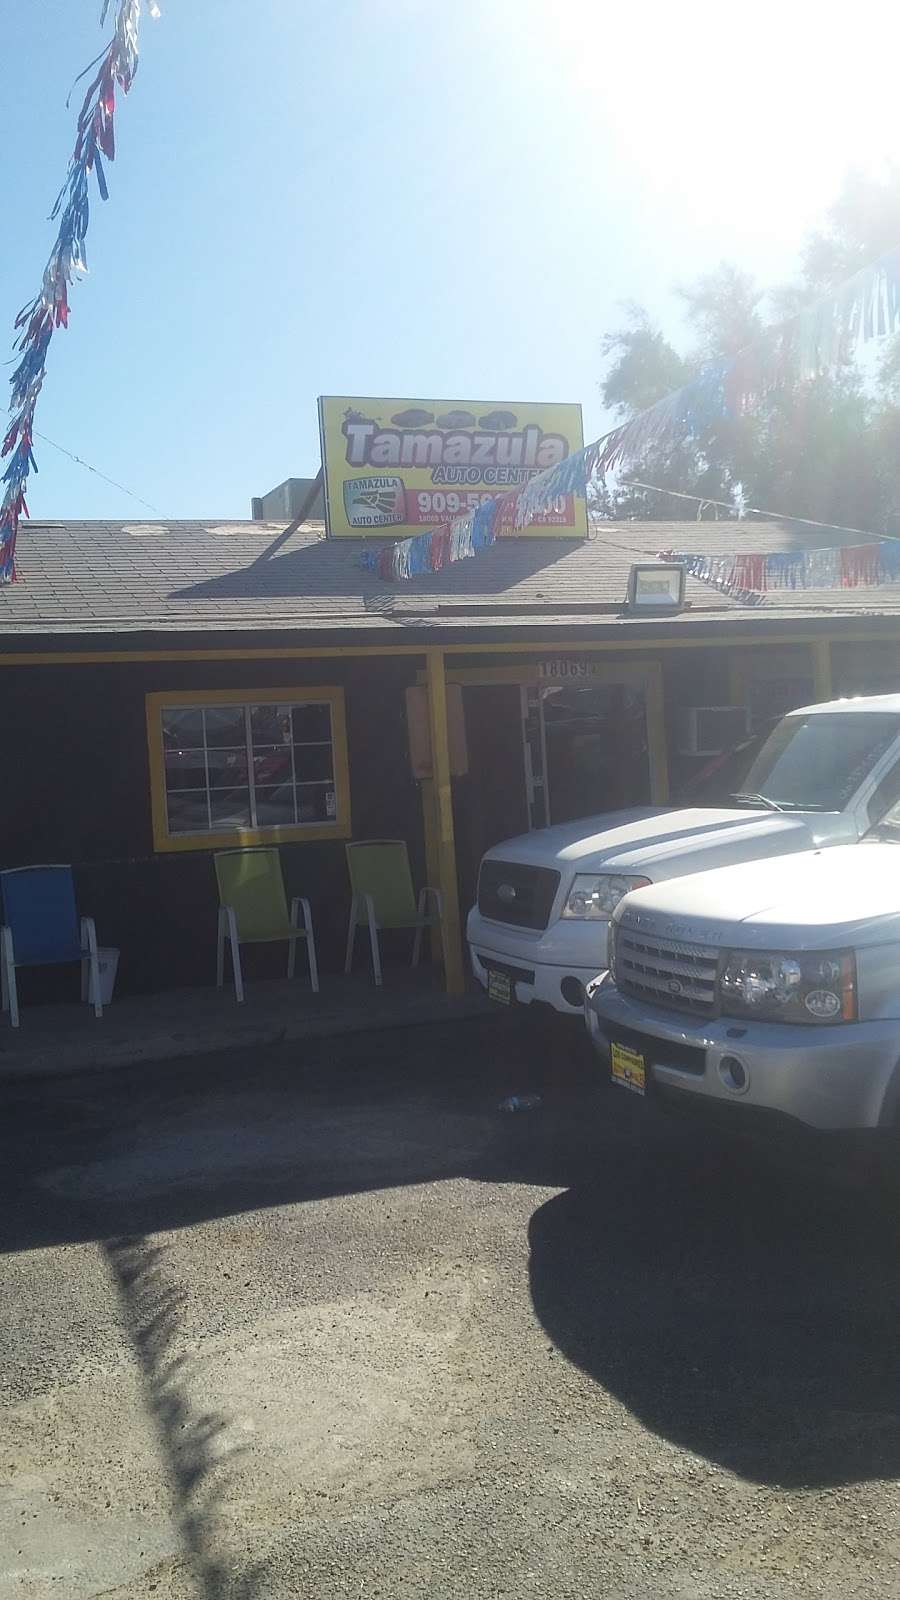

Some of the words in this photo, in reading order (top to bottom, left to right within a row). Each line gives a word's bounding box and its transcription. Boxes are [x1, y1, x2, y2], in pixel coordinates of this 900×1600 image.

[345, 423, 567, 467] Tamazula
[433, 466, 481, 484] AUTO
[484, 466, 546, 485] CENTE
[348, 479, 399, 489] TAMAZULA
[352, 514, 372, 525] AUTO
[375, 513, 402, 524] CENTER
